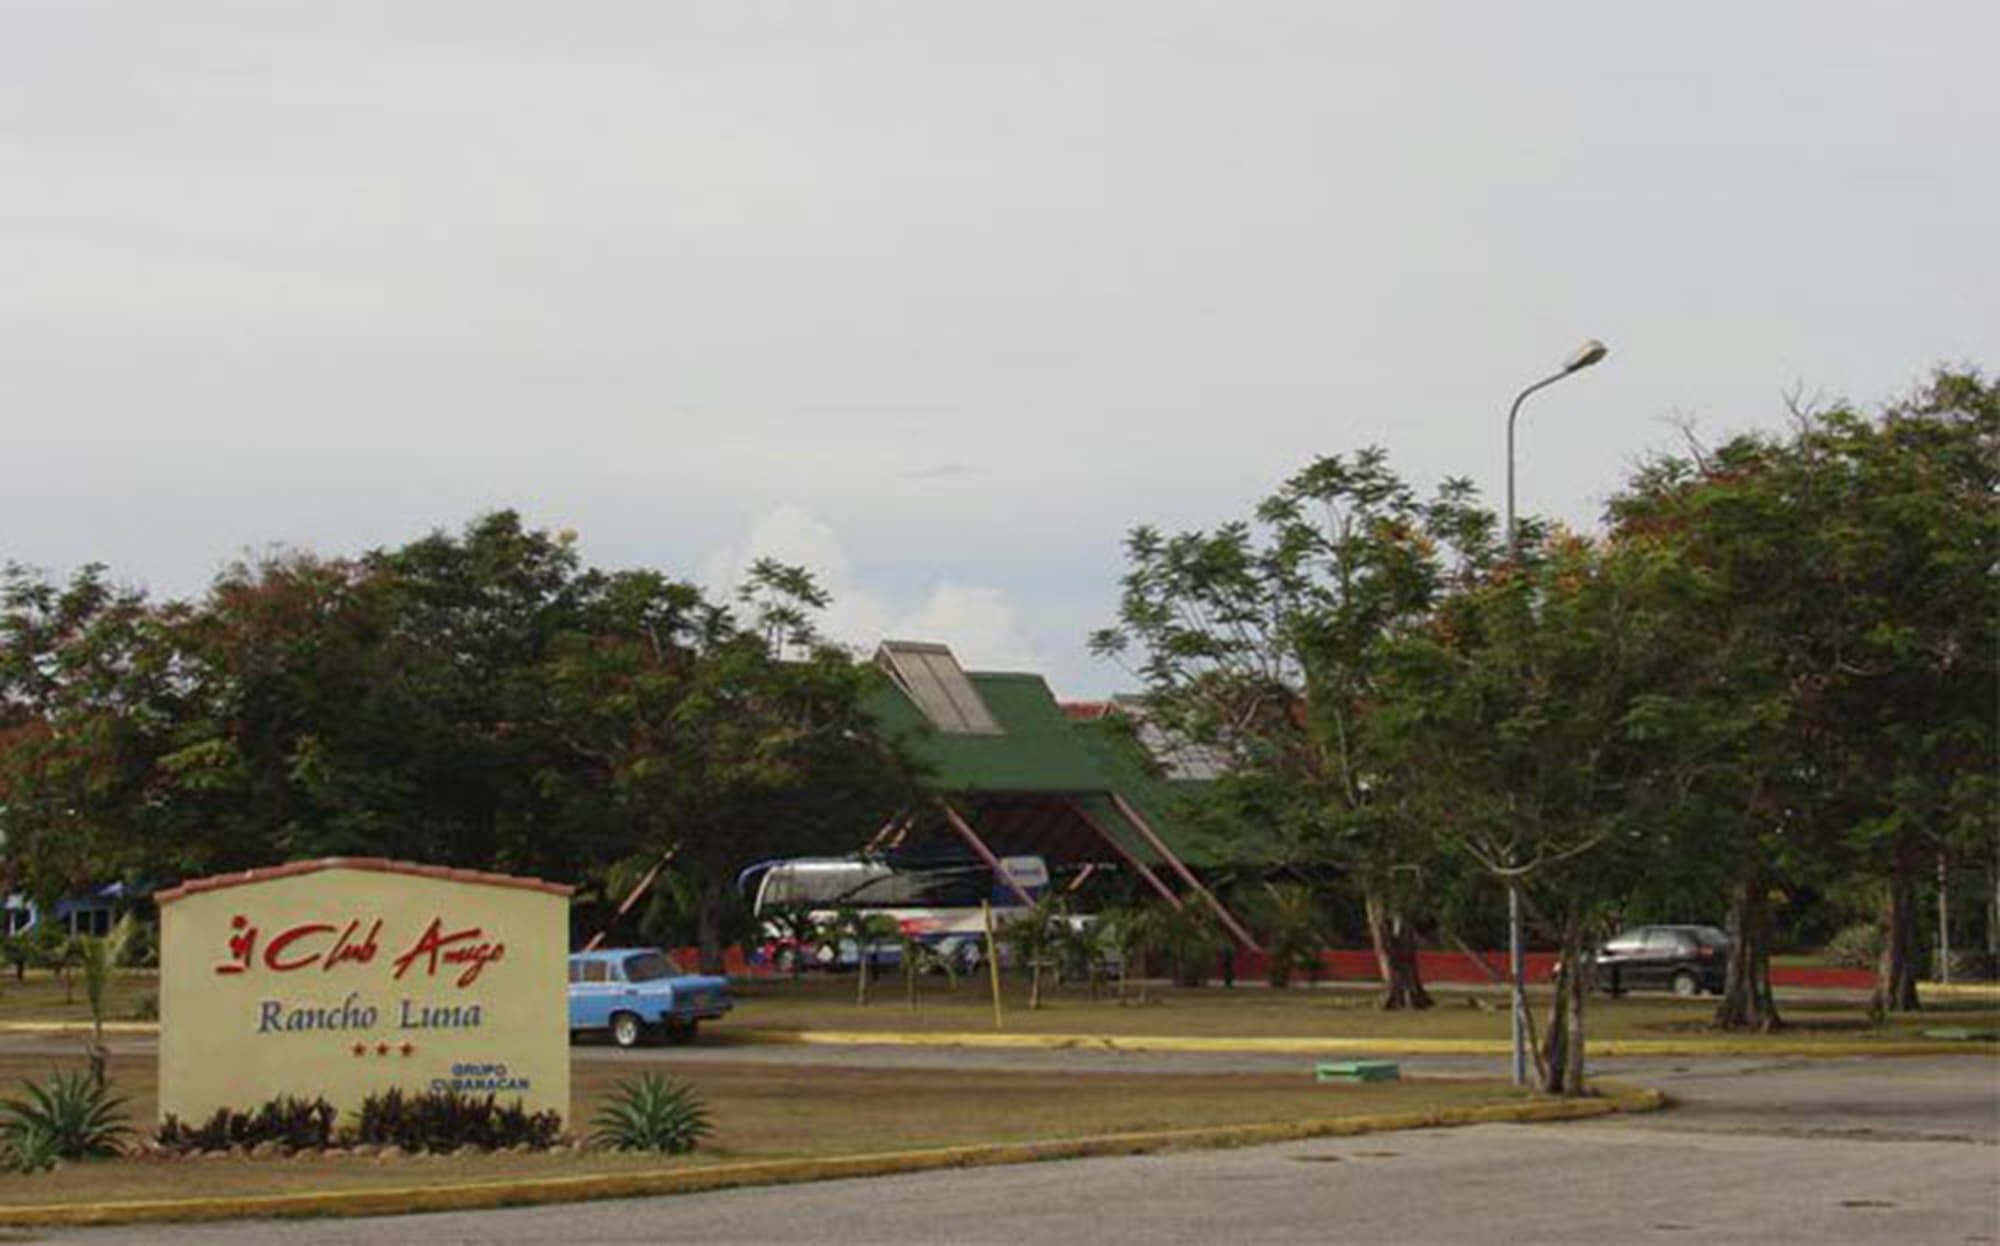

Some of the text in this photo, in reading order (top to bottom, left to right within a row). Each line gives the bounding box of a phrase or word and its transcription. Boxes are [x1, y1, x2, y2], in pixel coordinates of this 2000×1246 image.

[264, 917, 505, 988] Club Amigo
[258, 992, 481, 1033] Rancho Luna
[451, 1063, 507, 1076] GRUPO
